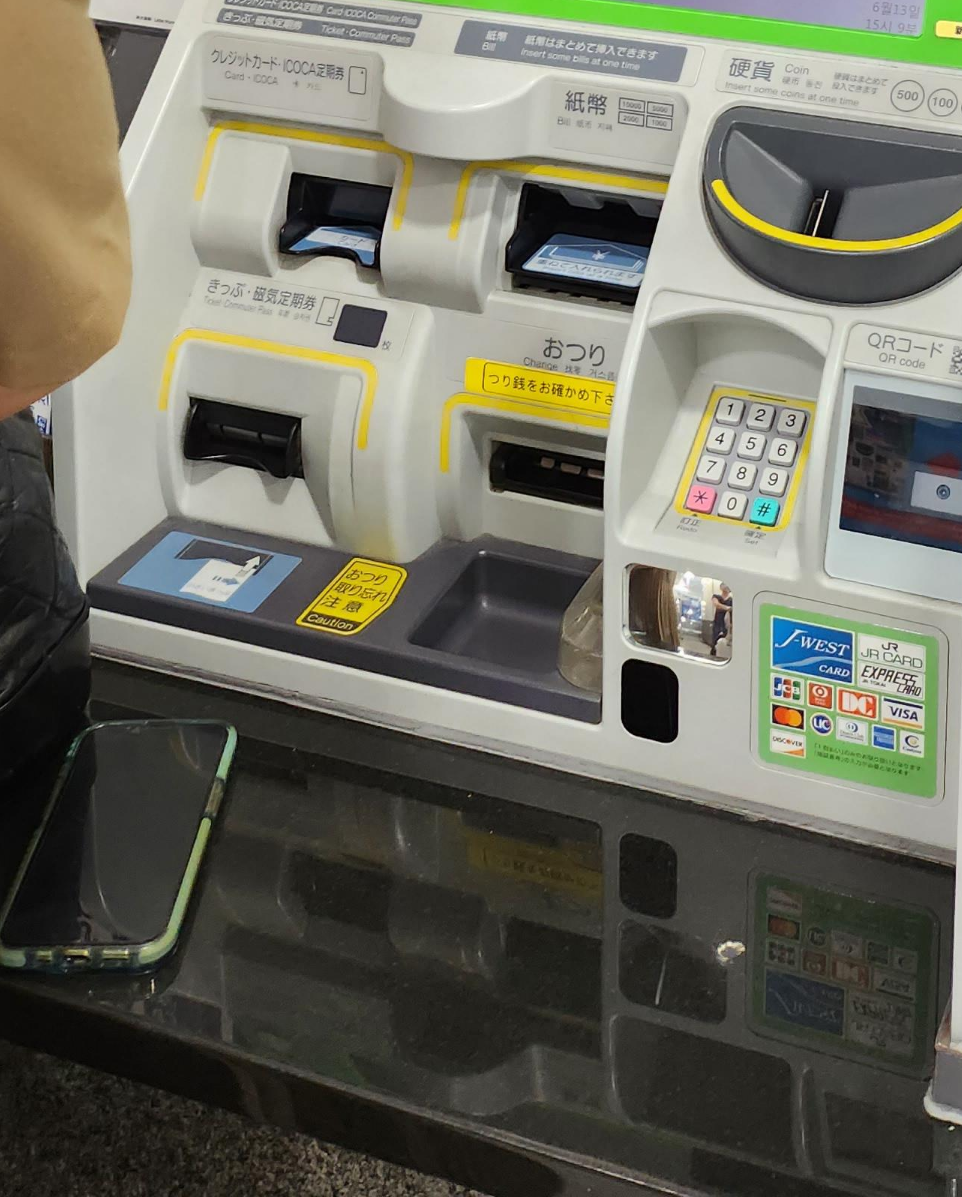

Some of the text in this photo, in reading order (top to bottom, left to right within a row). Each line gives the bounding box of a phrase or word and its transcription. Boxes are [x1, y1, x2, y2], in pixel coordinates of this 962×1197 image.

[728, 57, 776, 83] 硬貨
[784, 63, 810, 76] Coin
[563, 89, 609, 116] 紙幣
[896, 89, 920, 102] 500
[931, 96, 954, 109] 100
[543, 336, 606, 367] おつり
[867, 331, 944, 359] QRコード
[878, 352, 926, 370] QR code
[727, 403, 797, 427] 1 2 3
[714, 432, 788, 457] 4 5 6
[706, 460, 779, 486] 7 8 9
[346, 568, 389, 586] おつり
[335, 581, 387, 603] 取り忘れ
[307, 612, 355, 631] Caution
[860, 649, 923, 670] JR CARD
[818, 664, 851, 678] CARD
[861, 664, 918, 688] EXPRESS
[813, 716, 831, 730] UC
[888, 705, 919, 722] VISA
[772, 736, 803, 748] DISCOVER
